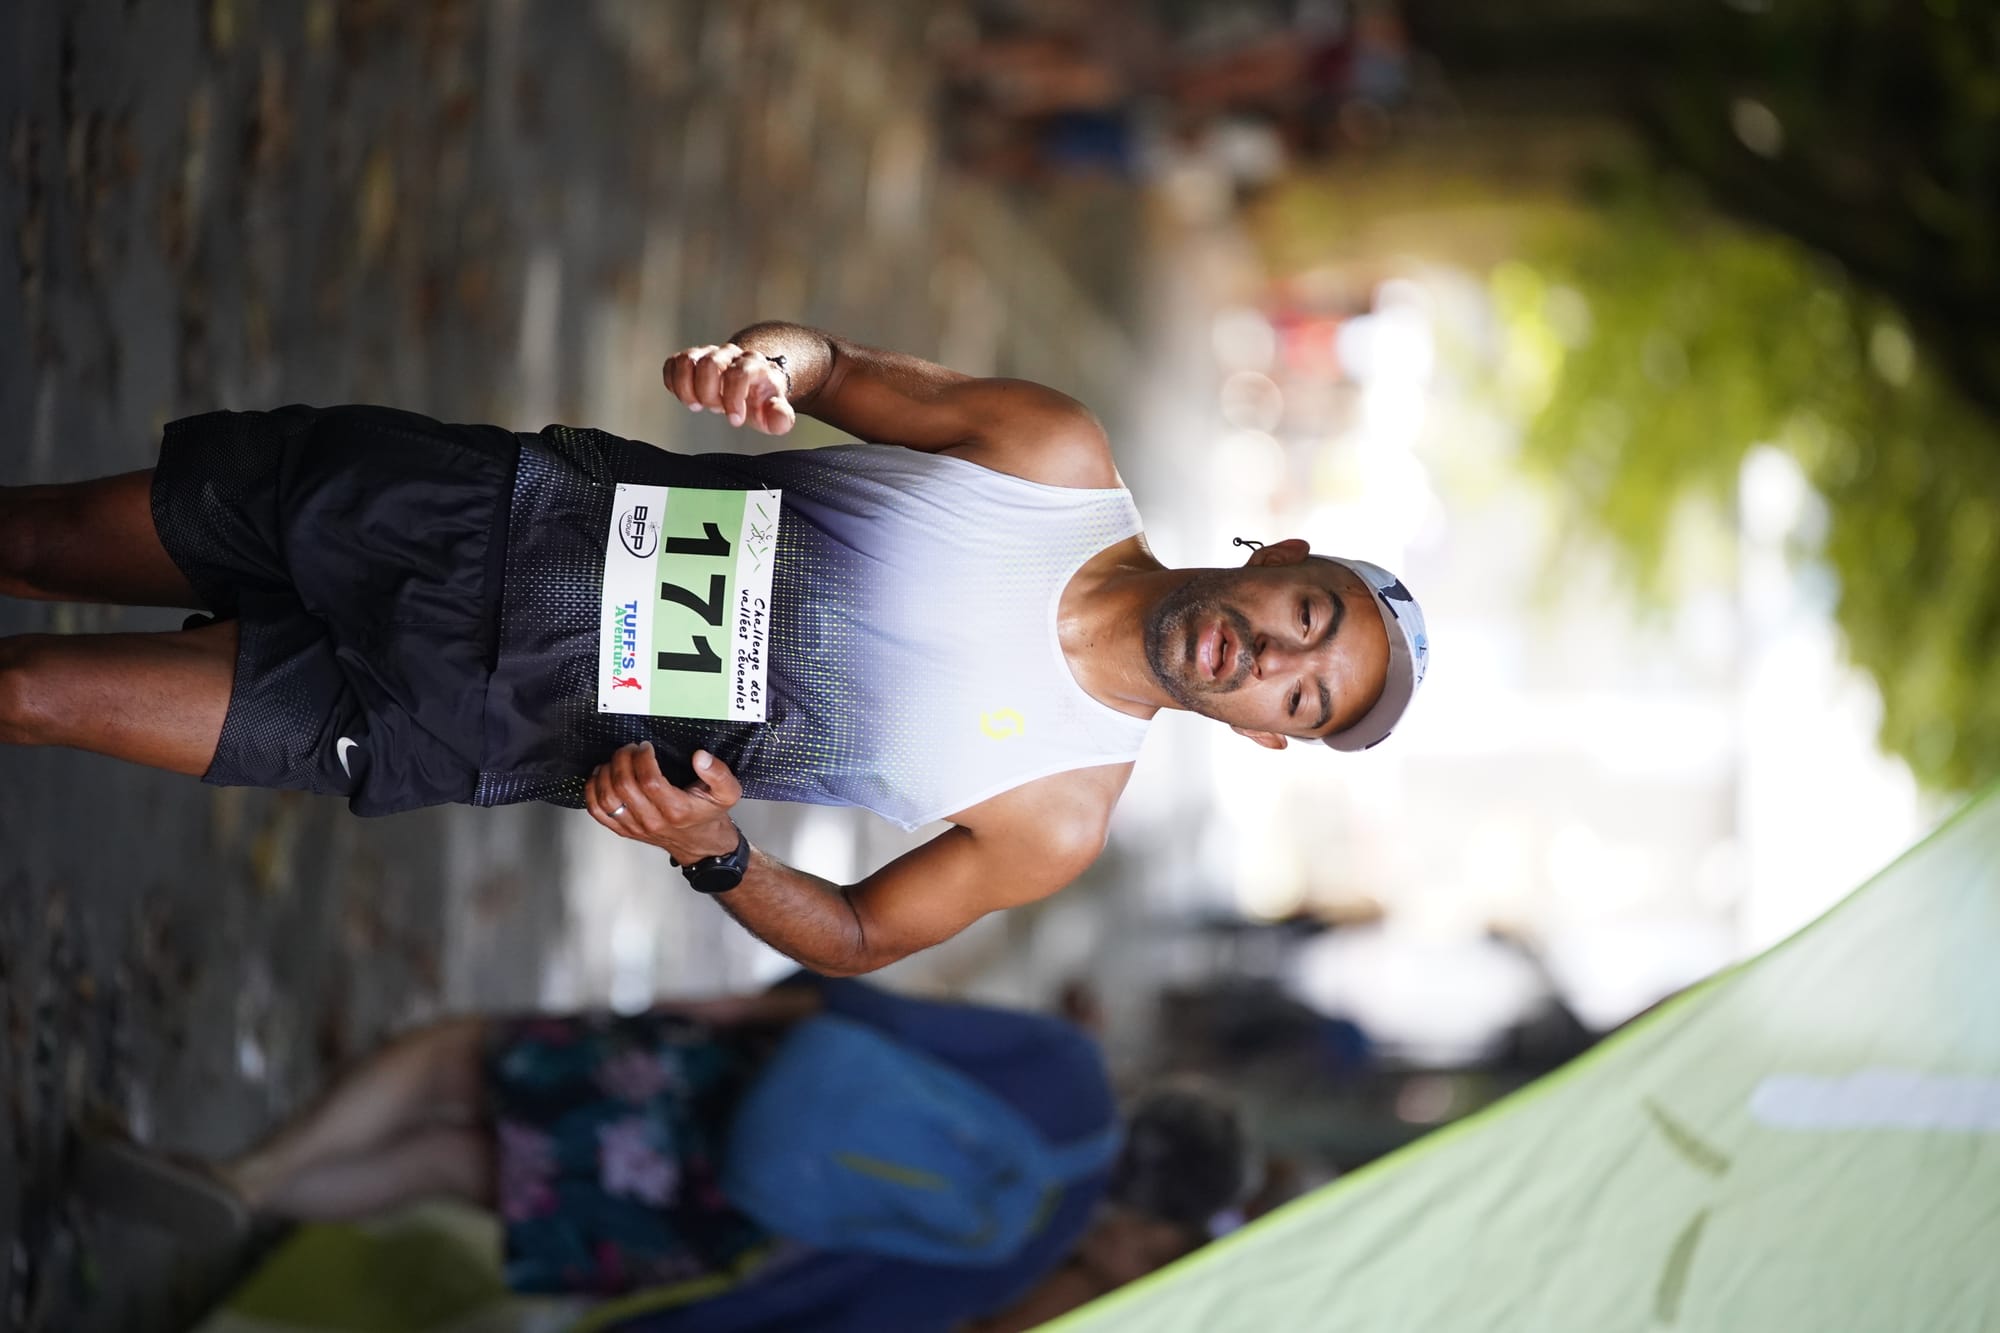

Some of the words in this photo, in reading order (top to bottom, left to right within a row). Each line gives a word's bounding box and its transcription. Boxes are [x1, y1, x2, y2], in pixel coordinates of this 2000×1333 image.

[625, 514, 633, 537] GROUP
[630, 505, 648, 550] BFP
[657, 522, 731, 673] 171
[739, 589, 751, 640] vallées
[613, 606, 627, 676] Aventure
[622, 600, 637, 669] TUFF'S
[748, 598, 765, 670] Challenge
[736, 648, 749, 711] cévenoles
[750, 680, 761, 704] des
